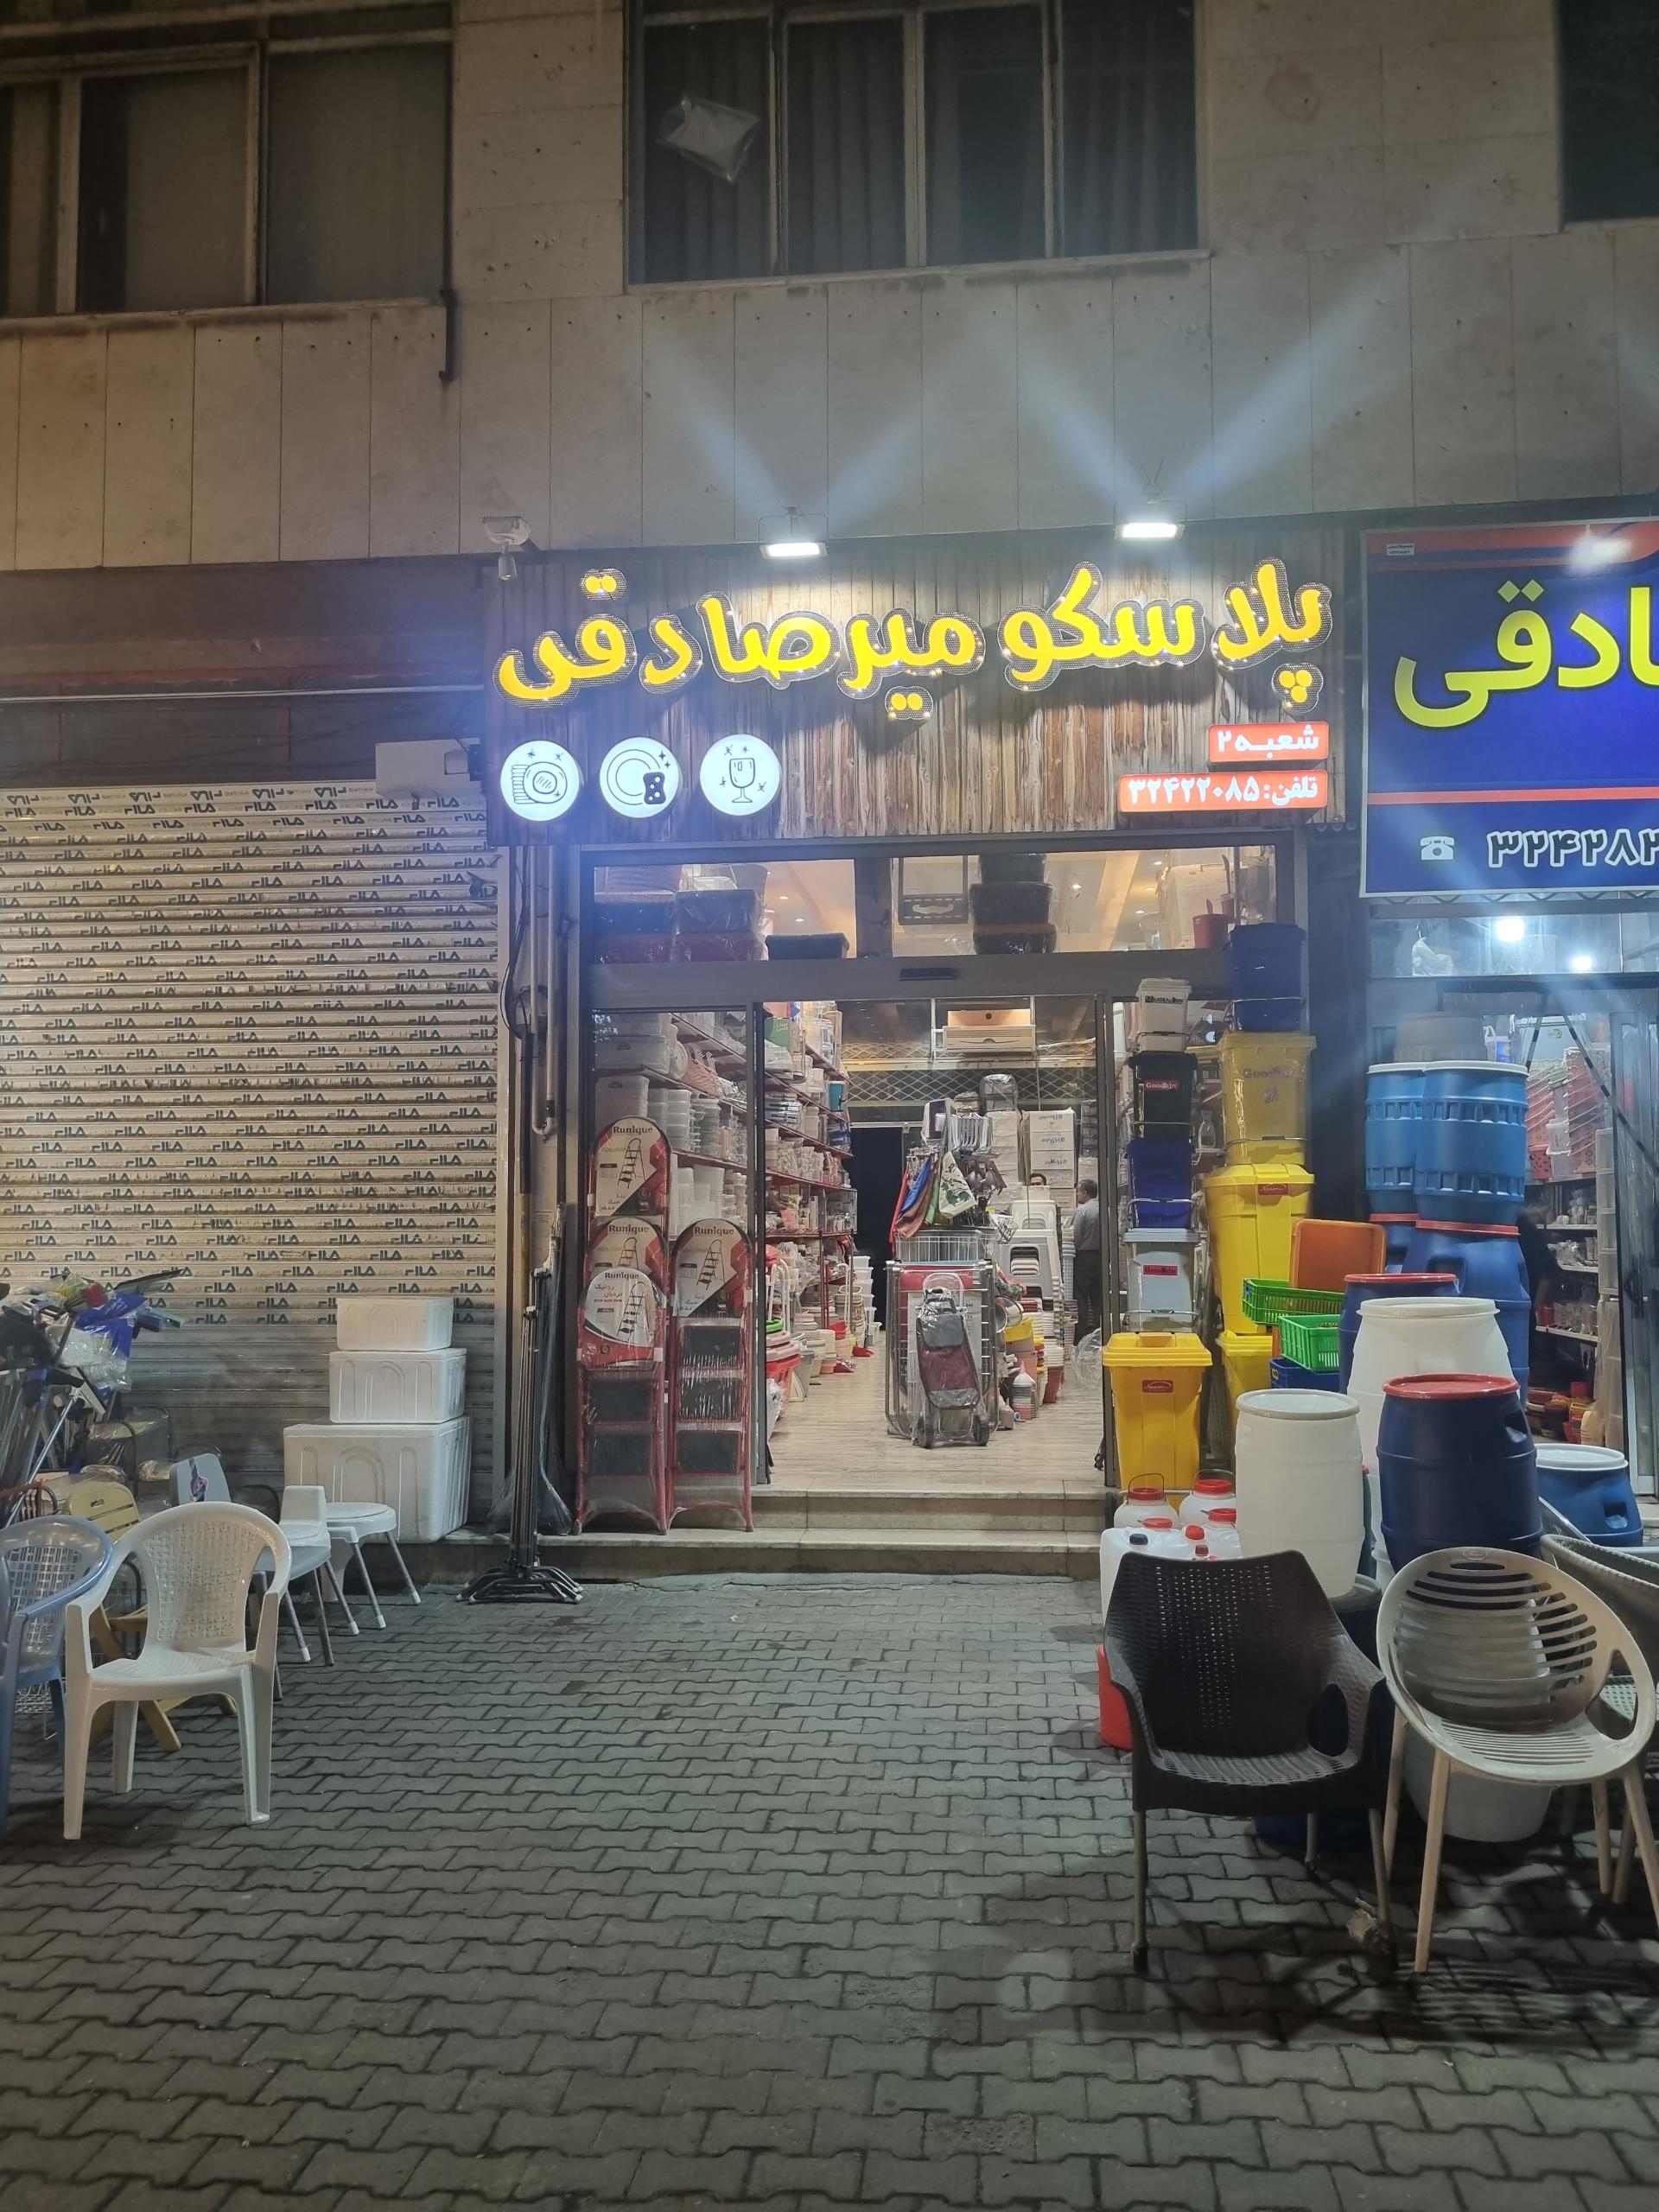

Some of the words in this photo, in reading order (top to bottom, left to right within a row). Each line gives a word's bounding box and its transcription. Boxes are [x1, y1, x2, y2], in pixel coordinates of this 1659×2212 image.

[1394, 579, 1659, 728] ادقی
[7, 794, 40, 805] FILA
[67, 792, 100, 804] FILA
[129, 791, 162, 802] FILA
[190, 789, 223, 800] FILA
[65, 805, 96, 817] FILA
[124, 804, 156, 815] FILA
[245, 801, 276, 812] FILA
[306, 799, 337, 810] FILA
[35, 822, 66, 832] FILA
[153, 819, 184, 830] FILA
[273, 817, 304, 827] FILA
[334, 815, 365, 825] FILA
[58, 834, 89, 846] FILA
[117, 832, 148, 844] FILA
[176, 831, 207, 843] FILA
[236, 830, 267, 842] FILA
[112, 848, 144, 860] FILA
[172, 847, 204, 859] FILA
[232, 845, 264, 857] FILA
[412, 842, 444, 854] FILA
[35, 865, 66, 877] FILA
[153, 862, 184, 874] FILA
[333, 859, 365, 871] FILA
[454, 856, 486, 868] FILA
[72, 880, 104, 892] FILA
[191, 877, 223, 889] FILA
[311, 874, 343, 887] FILA
[372, 874, 404, 886] FILA
[48, 895, 80, 907] FILA
[288, 891, 320, 903] FILA
[348, 890, 380, 902] FILA
[409, 888, 441, 900] FILA
[15, 911, 46, 923] FILA
[74, 910, 105, 922] FILA
[134, 909, 165, 921] FILA
[435, 904, 467, 916] FILA
[140, 924, 171, 936] FILA
[260, 922, 291, 934] FILA
[321, 921, 352, 933] FILA
[382, 920, 413, 932] FILA
[91, 940, 123, 952] FILA
[150, 939, 182, 951] FILA
[211, 938, 242, 950] FILA
[271, 938, 302, 950] FILA
[125, 955, 157, 967] FILA
[306, 952, 338, 964] FILA
[367, 951, 399, 963] FILA
[428, 950, 460, 963] FILA
[36, 972, 68, 984] FILA
[216, 969, 247, 982] FILA
[337, 968, 368, 980] FILA
[458, 968, 490, 978] FILA
[86, 987, 117, 999] FILA
[145, 986, 176, 998] FILA
[205, 985, 236, 997] FILA
[72, 1002, 103, 1014] FILA
[131, 1001, 163, 1014] FILA
[192, 1001, 223, 1013] FILA
[252, 1000, 283, 1012] FILA
[105, 1017, 137, 1029] FILA
[164, 1016, 196, 1028] FILA
[225, 1015, 257, 1027] FILA
[286, 1014, 317, 1027] FILA
[106, 1033, 138, 1045] FILA
[226, 1031, 258, 1043] FILA
[287, 1030, 319, 1042] FILA
[348, 1029, 380, 1041] FILA
[6, 1049, 38, 1061] FILA
[66, 1048, 98, 1060] FILA
[126, 1047, 158, 1059] FILA
[430, 1044, 462, 1056] FILA
[154, 1063, 186, 1075] FILA
[214, 1062, 246, 1074] FILA
[396, 1060, 428, 1072] FILA
[457, 1059, 489, 1071] FILA
[403, 1076, 434, 1088] FILA
[464, 1075, 495, 1087] FILA
[53, 1095, 85, 1107] FILA
[113, 1094, 144, 1106] FILA
[232, 1093, 264, 1105] FILA
[294, 1092, 325, 1104] FILA
[145, 1109, 177, 1122] FILA
[206, 1109, 238, 1121] FILA
[388, 1107, 420, 1119] FILA
[449, 1107, 481, 1119] FILA
[114, 1125, 146, 1137] FILA
[235, 1124, 267, 1136] FILA
[358, 1123, 390, 1135] FILA
[419, 1122, 451, 1135] FILA
[613, 1125, 653, 1135] Runique
[212, 1140, 244, 1152] FILA
[334, 1139, 365, 1151] FILA
[395, 1138, 427, 1150] FILA
[456, 1138, 488, 1150] FILA
[5, 1158, 37, 1168] FILA
[65, 1157, 97, 1167] FILA
[368, 1154, 400, 1166] FILA
[429, 1154, 461, 1166] FILA
[99, 1172, 130, 1184] FILA
[219, 1171, 251, 1183] FILA
[281, 1171, 312, 1183] FILA
[403, 1170, 435, 1182] FILA
[103, 1187, 135, 1199] FILA
[162, 1187, 194, 1199] FILA
[284, 1186, 316, 1198] FILA
[3, 1204, 35, 1216] FILA
[123, 1203, 155, 1215] FILA
[184, 1203, 216, 1215] FILA
[429, 1201, 461, 1213] FILA
[141, 1219, 173, 1230] FILA
[323, 1217, 355, 1230] FILA
[385, 1217, 416, 1229] FILA
[447, 1217, 479, 1229] FILA
[608, 1224, 649, 1235] Runique
[694, 1226, 734, 1236] Runique
[25, 1236, 57, 1246] FILA
[145, 1235, 177, 1245] FILA
[329, 1233, 361, 1245] FILA
[391, 1233, 423, 1245] FILA
[64, 1250, 96, 1261] FILA
[124, 1250, 156, 1261] FILA
[186, 1250, 218, 1261] FILA
[370, 1250, 402, 1261] FILA
[100, 1266, 132, 1276] FILA
[221, 1266, 253, 1276] FILA
[283, 1266, 315, 1276] FILA
[343, 1266, 375, 1276] FILA
[605, 1272, 639, 1281] Runique
[204, 1281, 236, 1292] FILA
[327, 1282, 359, 1293] FILA
[388, 1282, 420, 1293] FILA
[450, 1282, 482, 1293] FILA
[195, 1298, 227, 1308] FILA
[257, 1298, 289, 1308] FILA
[195, 1313, 227, 1324] FILA
[257, 1313, 289, 1324] FILA
